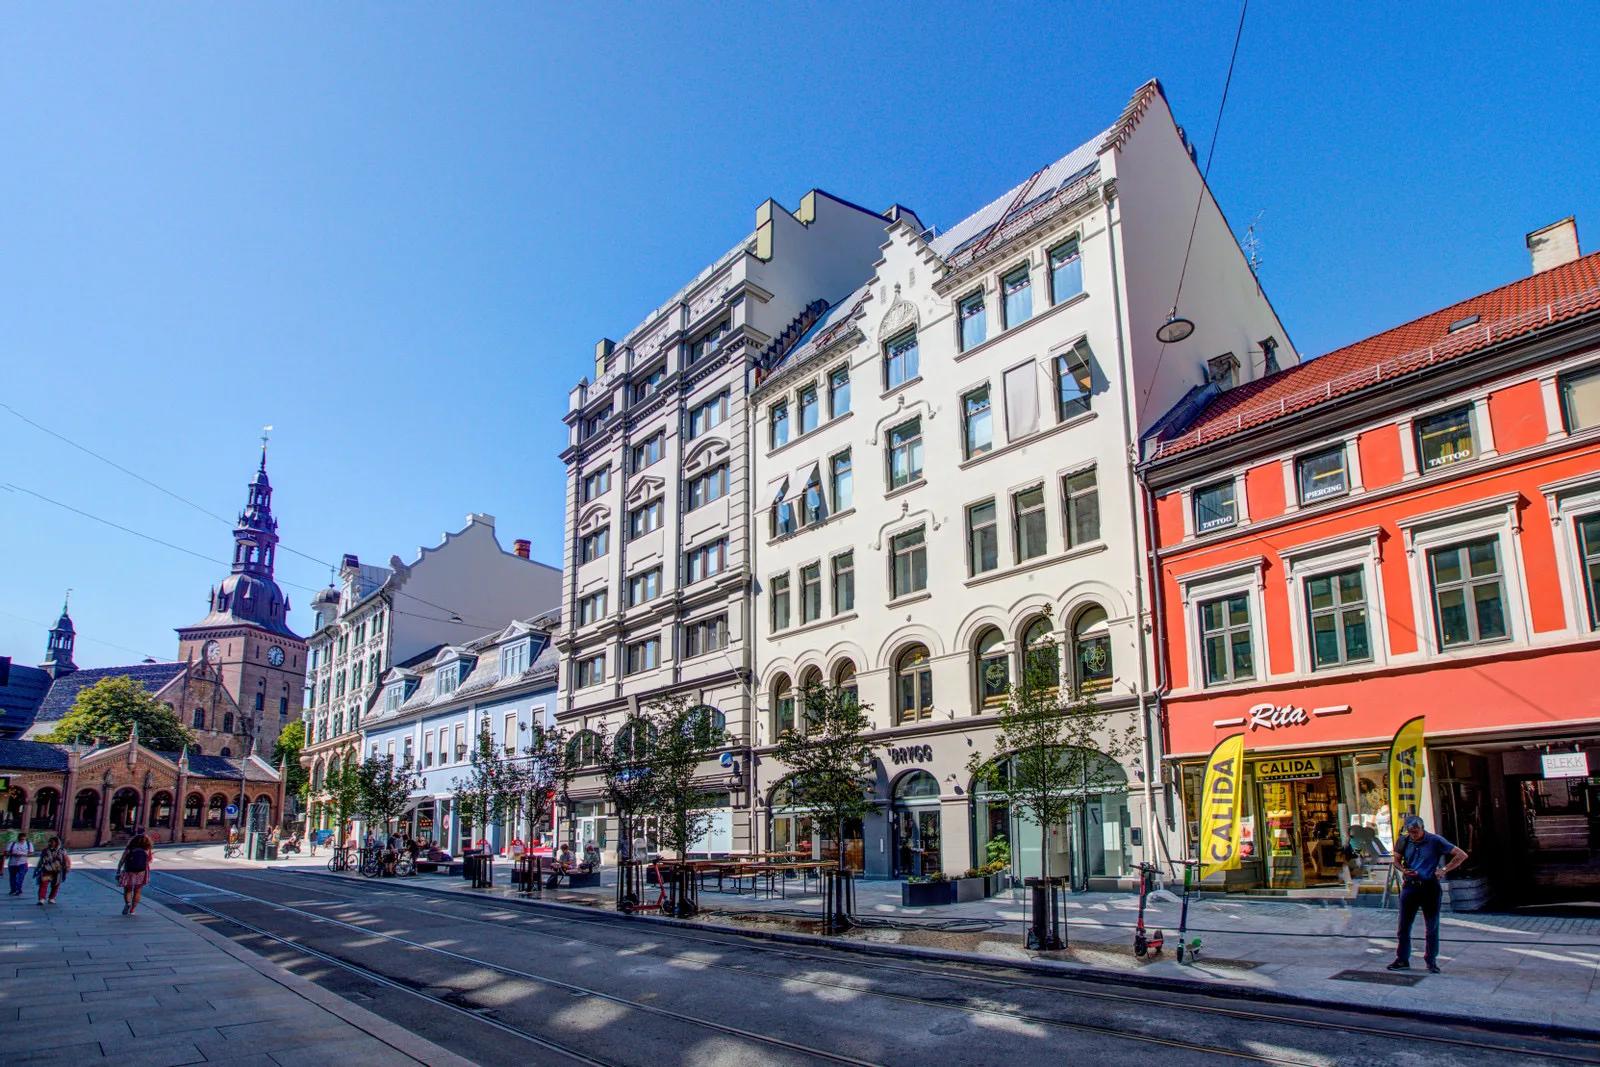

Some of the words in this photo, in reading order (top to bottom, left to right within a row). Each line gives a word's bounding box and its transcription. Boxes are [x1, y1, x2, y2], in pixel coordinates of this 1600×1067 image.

[1429, 450, 1470, 466] TATTOO
[1306, 484, 1342, 499] PIERCING
[1202, 515, 1232, 529] TATTOO
[1249, 703, 1308, 731] Rita
[1260, 760, 1315, 774] CALIDA
[1546, 757, 1584, 769] BLEKK
[1396, 746, 1416, 824] LIDA
[1211, 757, 1234, 862] CALIDA
